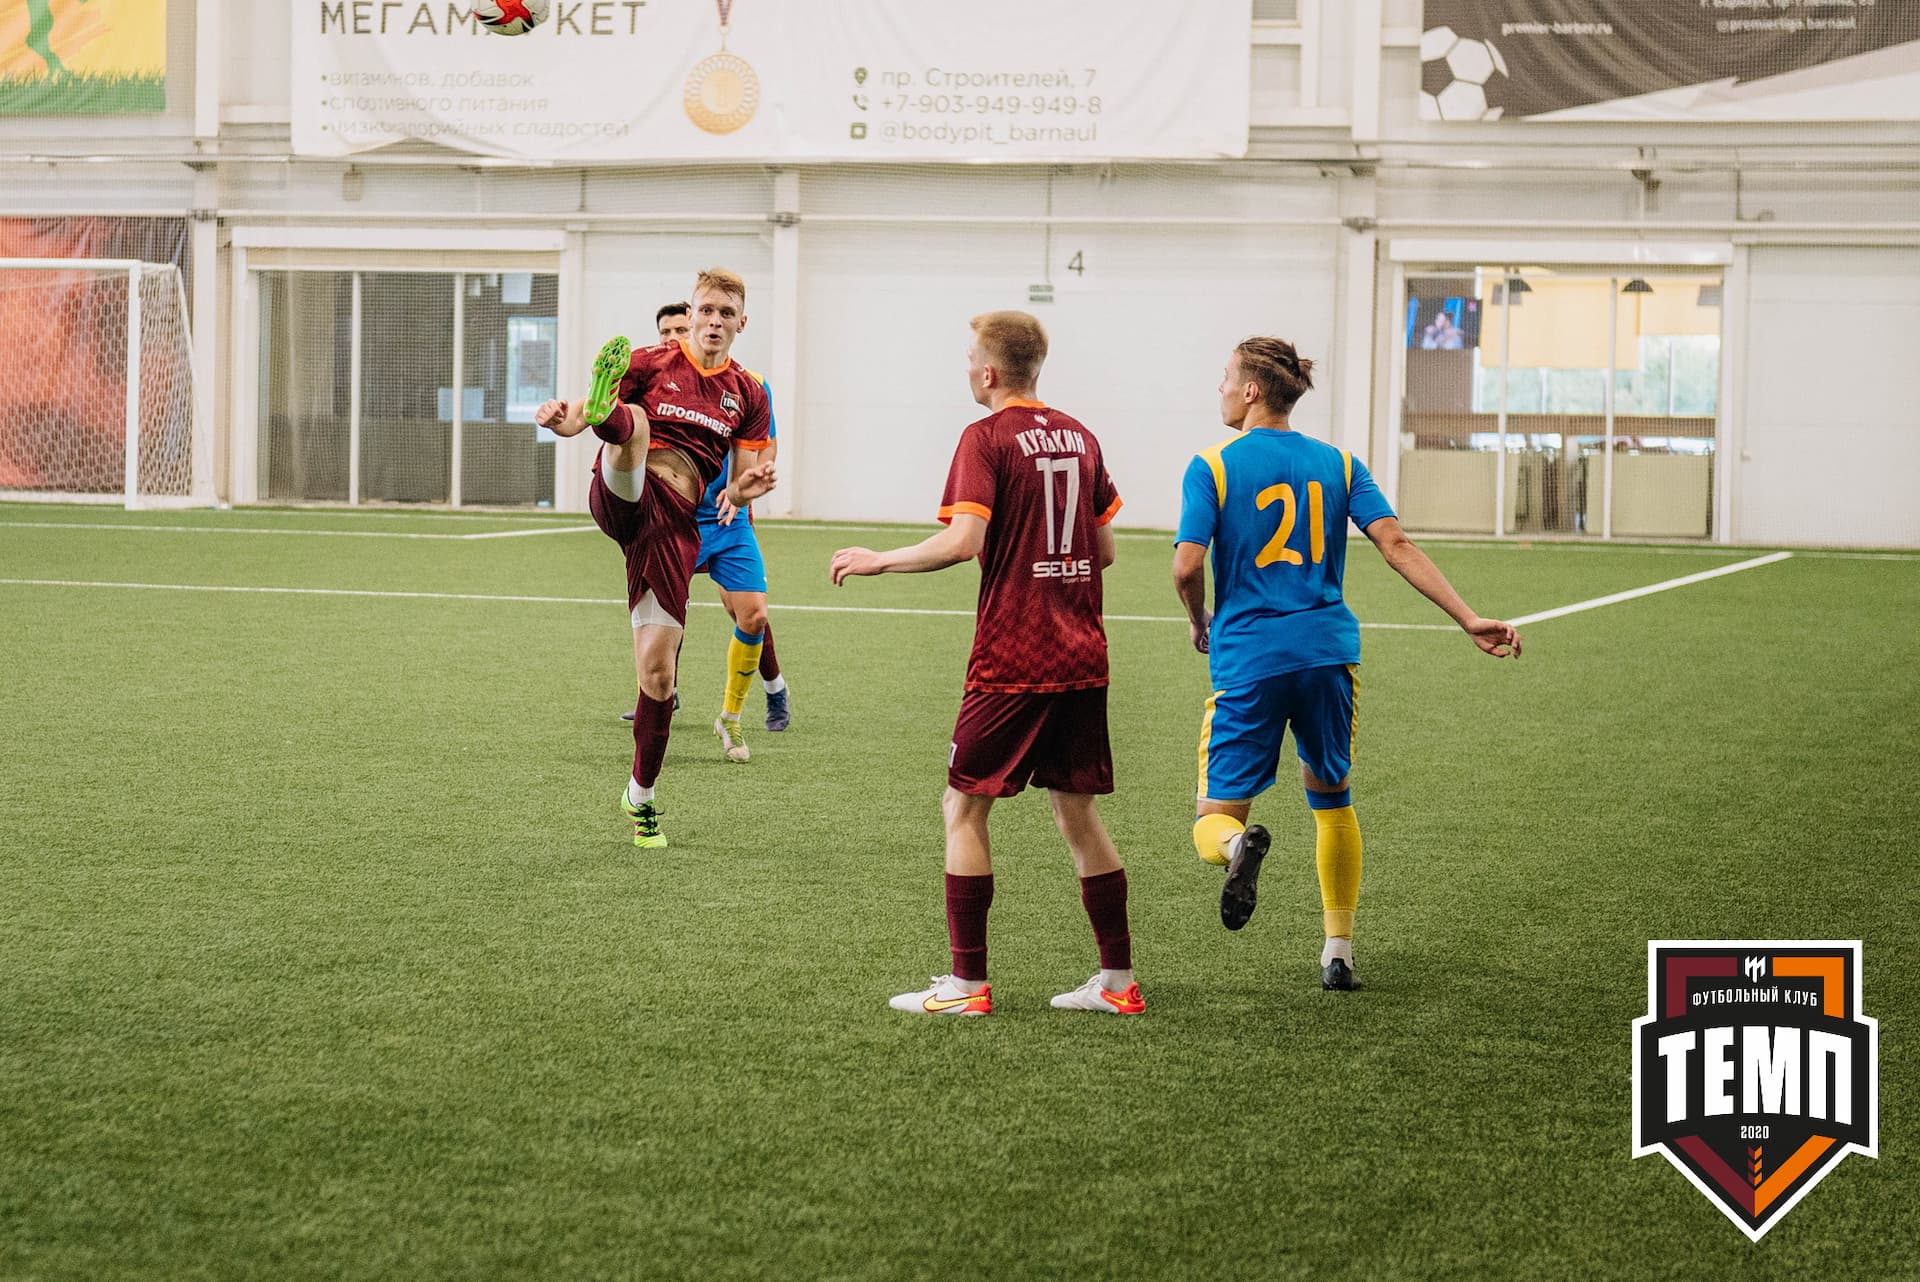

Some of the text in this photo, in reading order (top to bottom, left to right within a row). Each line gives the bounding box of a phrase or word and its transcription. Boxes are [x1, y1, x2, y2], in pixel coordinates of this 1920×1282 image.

[320, 1, 646, 35] МЕГАМКЕТ
[440, 71, 535, 90] добавок
[881, 66, 1098, 89] пр. Строителей, 7
[458, 97, 549, 113] питания
[880, 95, 1102, 115] +7-903-949-949-8
[512, 118, 631, 139] сладостей
[878, 121, 1097, 145] @bodypit_barnaul
[1067, 249, 1086, 277] 4
[1015, 427, 1087, 458] КУЗЬКИН
[1035, 456, 1081, 555] 17
[1254, 480, 1326, 569] 21
[1032, 557, 1092, 579] SEUS
